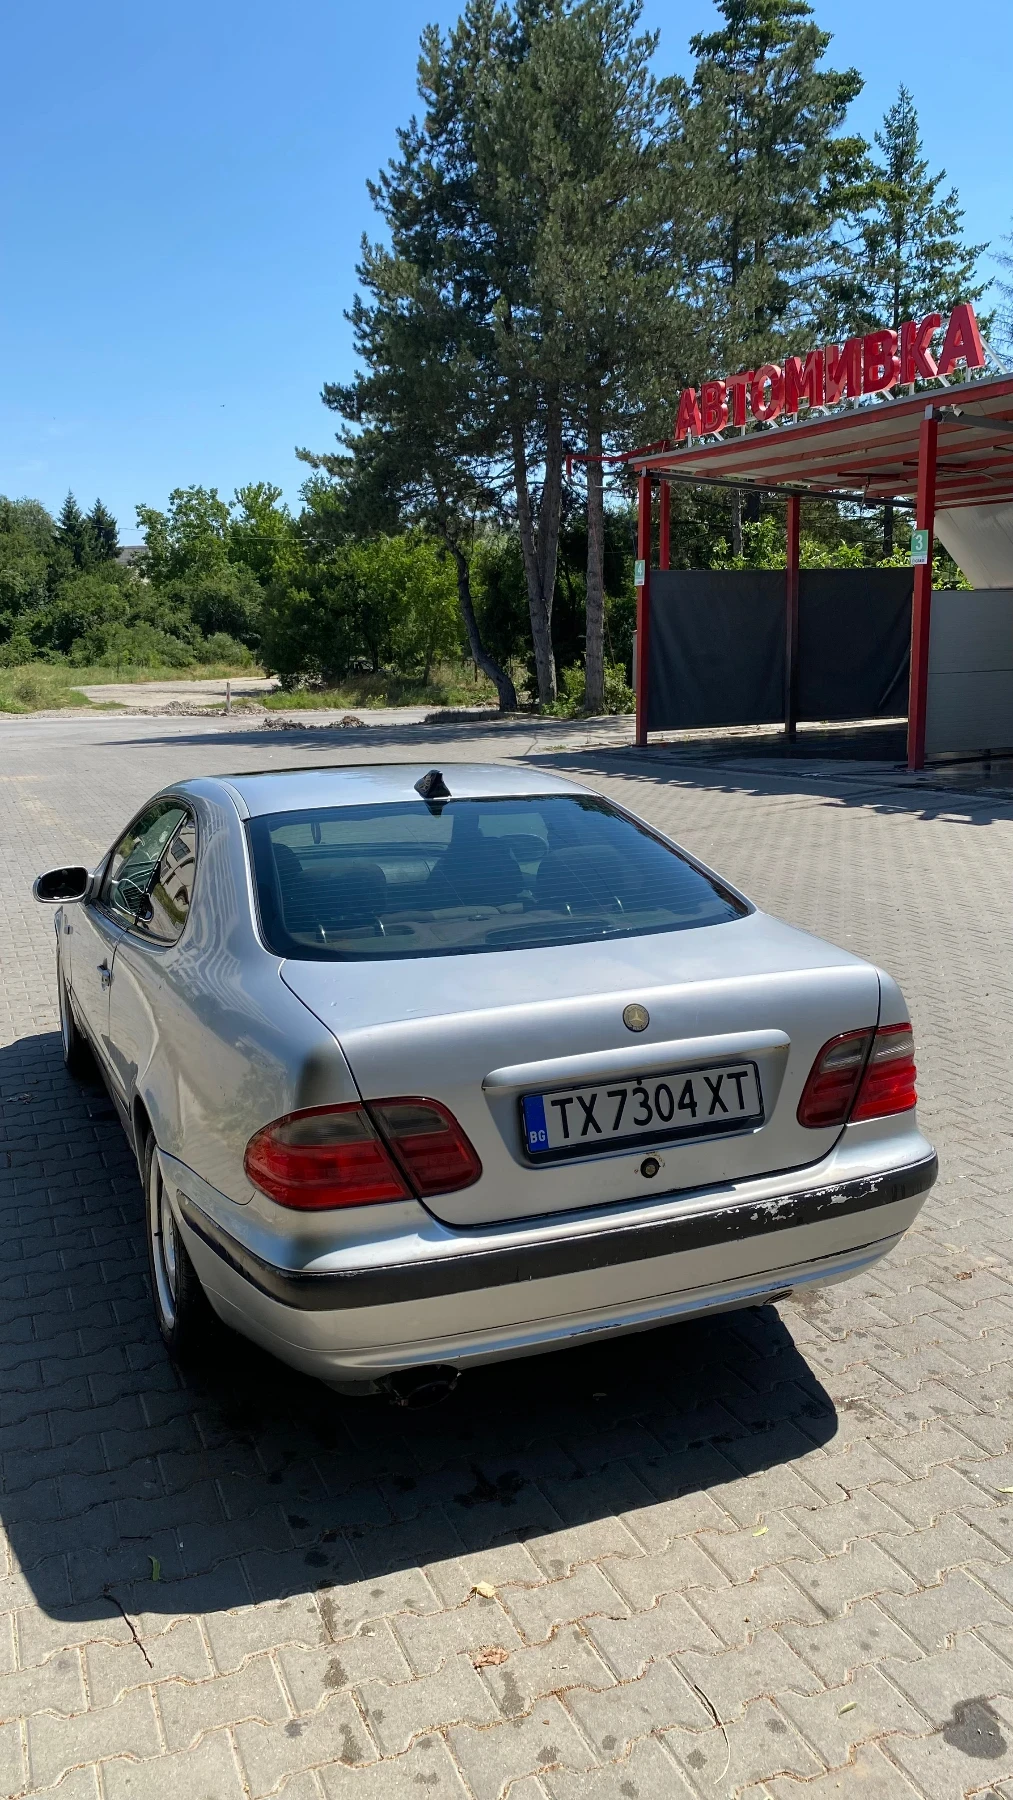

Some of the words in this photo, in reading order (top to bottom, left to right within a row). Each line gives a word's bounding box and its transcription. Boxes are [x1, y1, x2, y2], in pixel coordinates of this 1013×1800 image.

[674, 303, 986, 442] АВТОМИВКА
[915, 534, 923, 551] 3
[529, 1130, 546, 1144] BG
